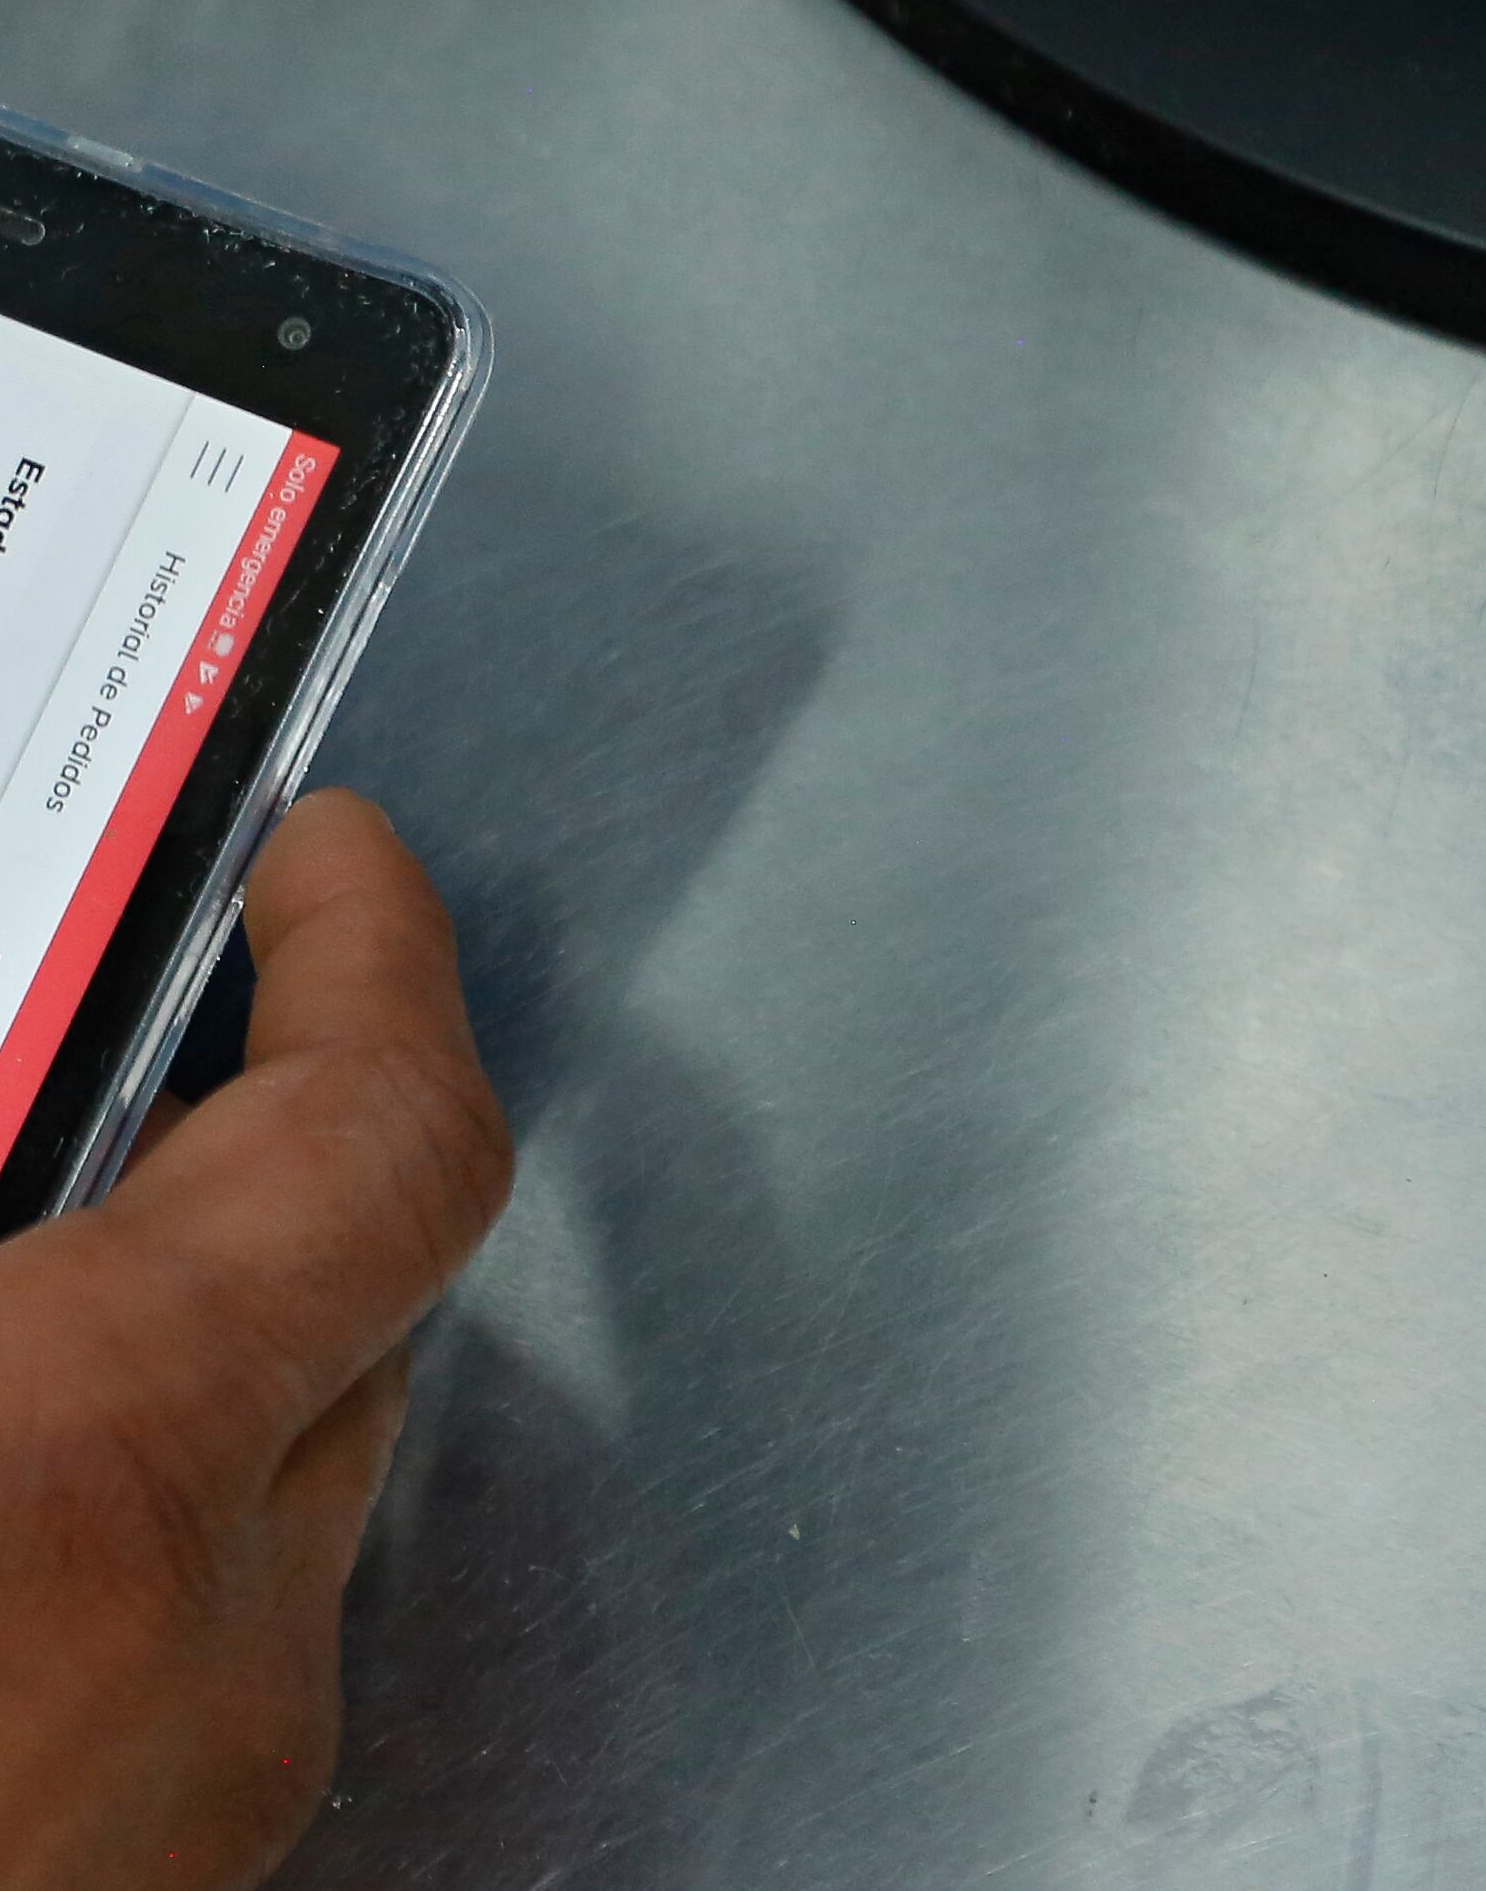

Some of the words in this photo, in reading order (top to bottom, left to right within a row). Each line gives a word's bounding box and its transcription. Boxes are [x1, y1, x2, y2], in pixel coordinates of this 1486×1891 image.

[277, 453, 317, 503] Solo
[116, 550, 186, 662] Historial
[218, 506, 287, 630] emergencia
[99, 666, 128, 701] de
[45, 705, 112, 813] Pedidos
